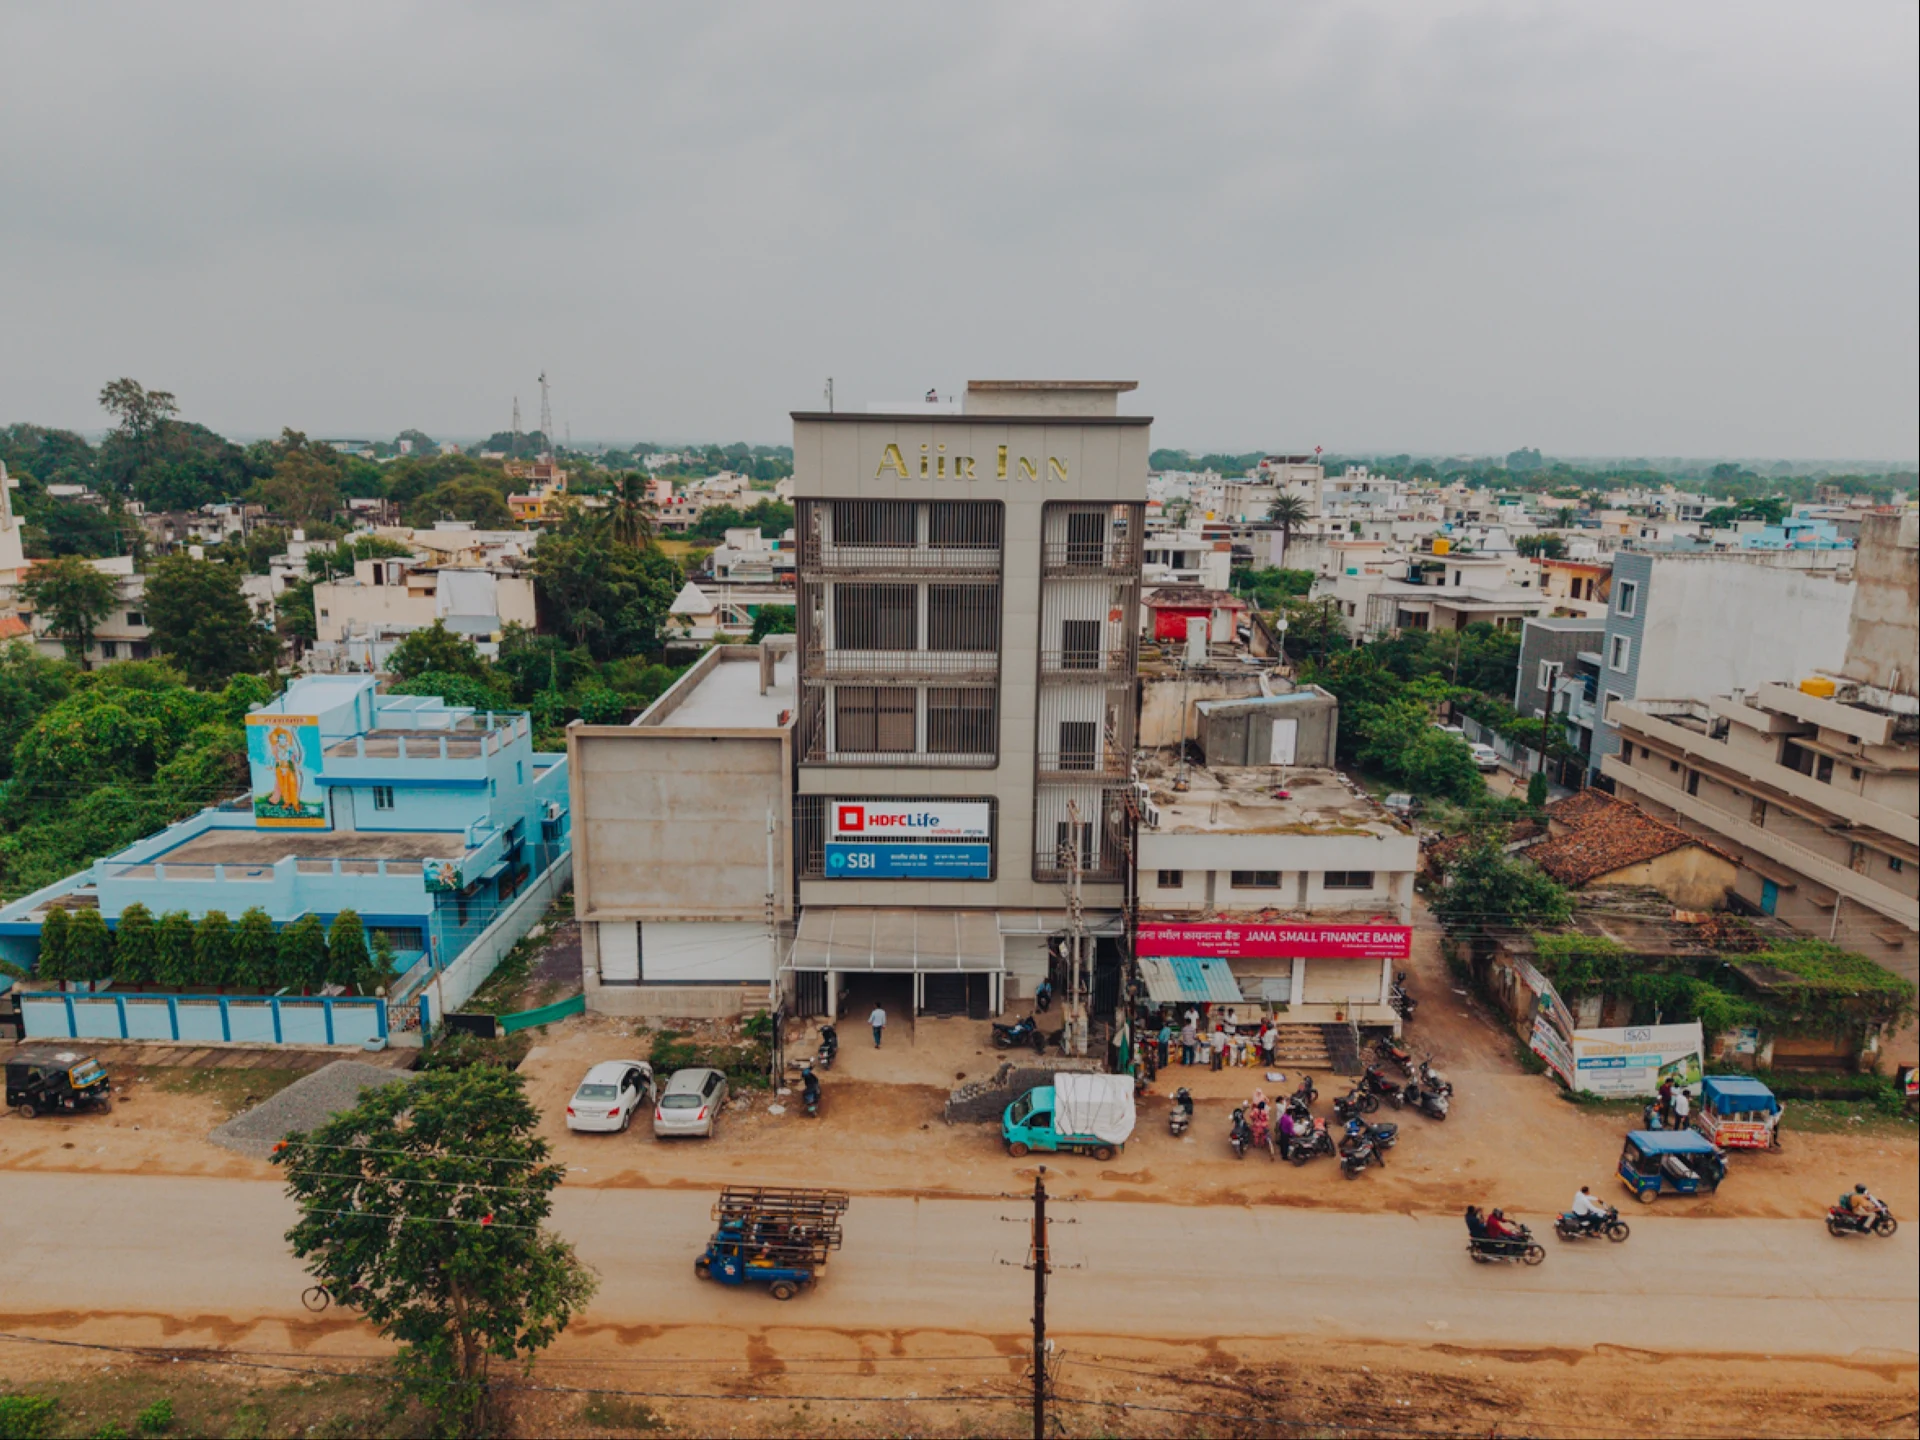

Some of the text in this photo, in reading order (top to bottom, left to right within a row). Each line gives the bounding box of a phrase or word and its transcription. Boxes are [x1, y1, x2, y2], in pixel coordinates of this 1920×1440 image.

[848, 853, 875, 868] SBI
[1245, 931, 1405, 944] JANA SMALL FINANCE BANK
